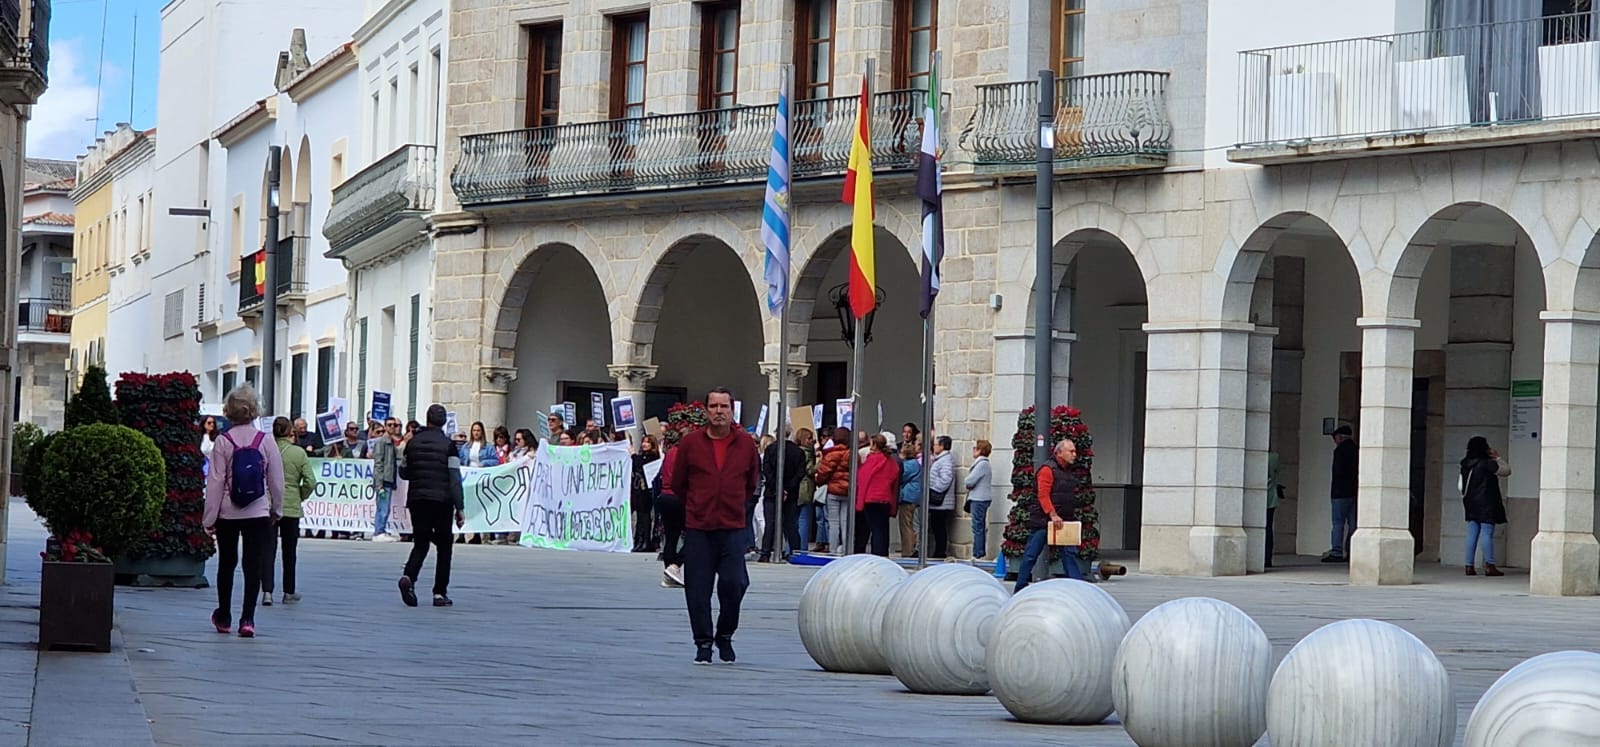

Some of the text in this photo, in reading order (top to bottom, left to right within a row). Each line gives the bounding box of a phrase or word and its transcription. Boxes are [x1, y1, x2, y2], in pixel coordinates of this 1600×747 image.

[321, 462, 374, 479] BUENA
[561, 463, 585, 496] UNA
[587, 460, 624, 492] BUENA
[315, 480, 375, 500] OTACIÓ
[306, 500, 359, 518] SIDENCIA
